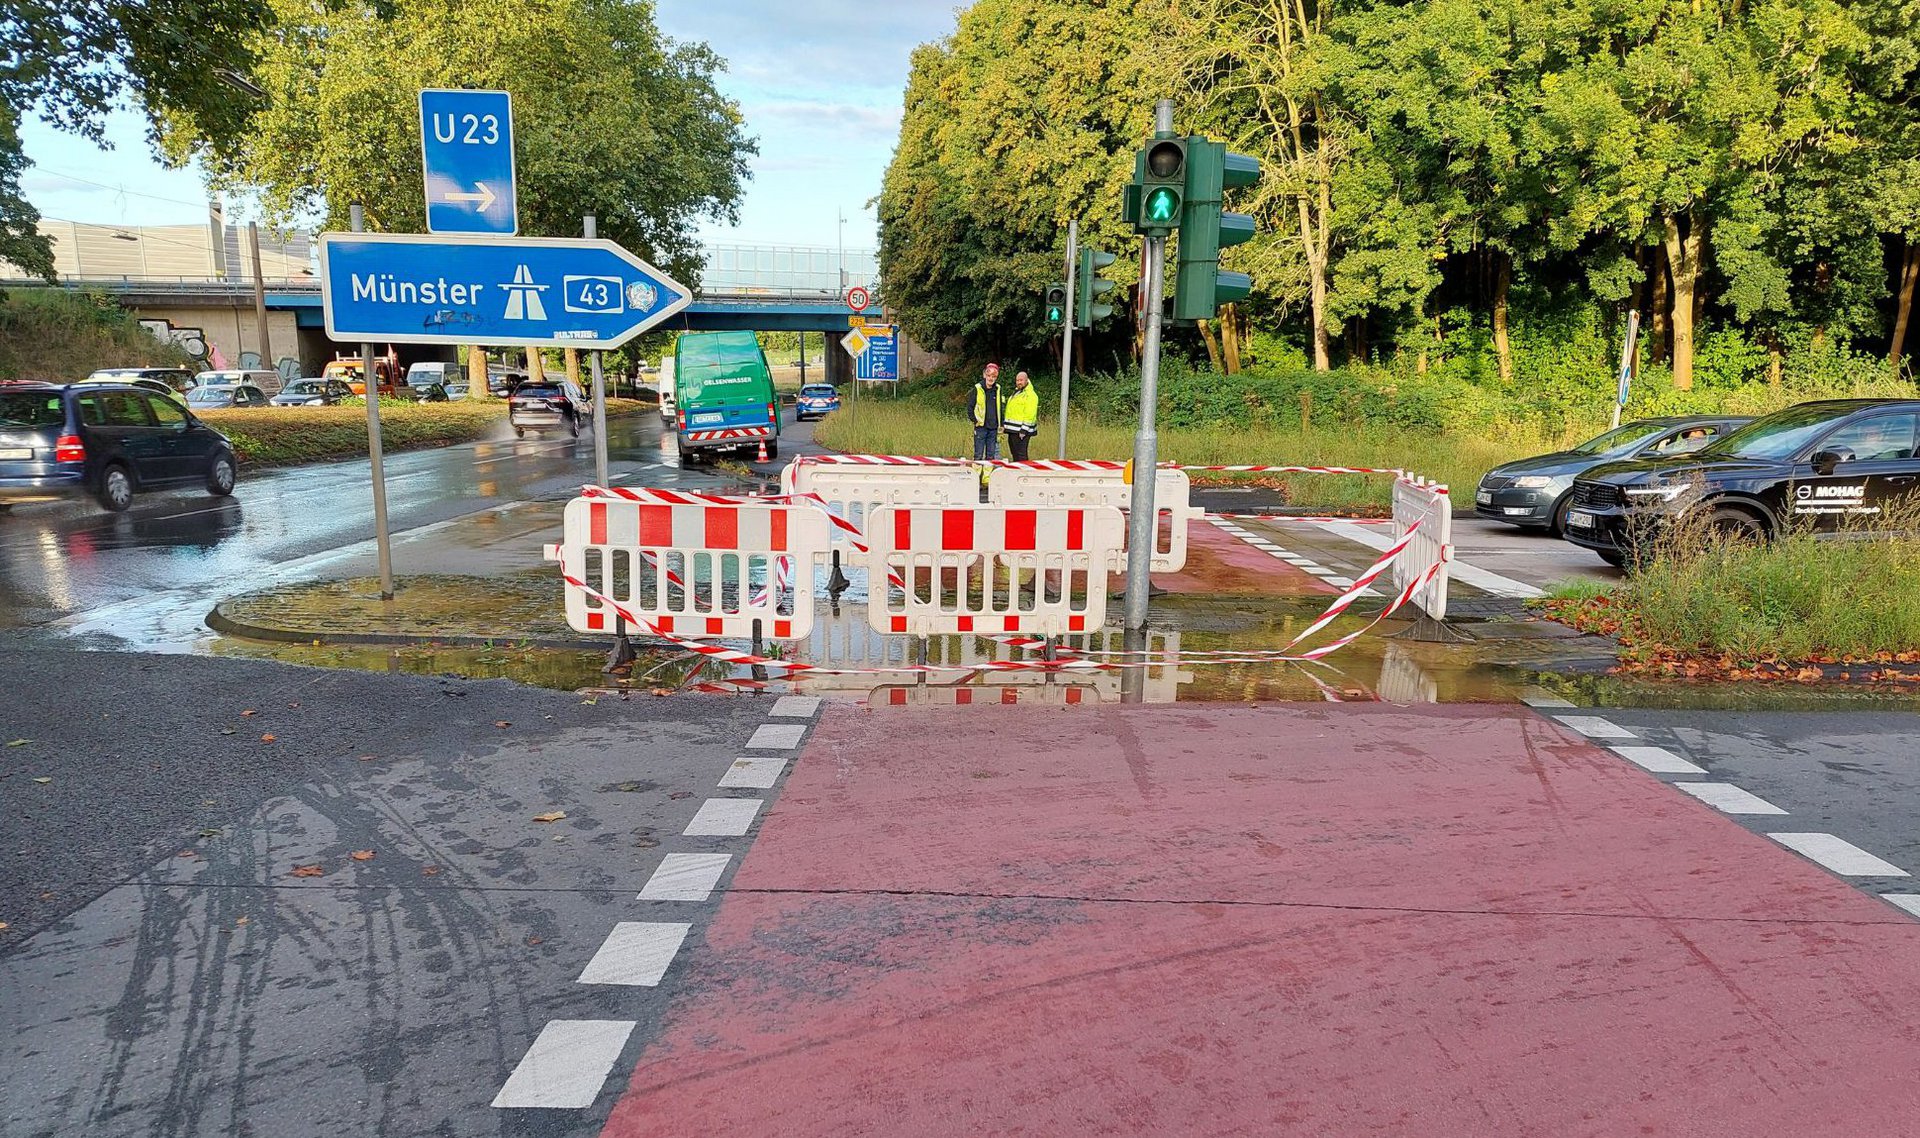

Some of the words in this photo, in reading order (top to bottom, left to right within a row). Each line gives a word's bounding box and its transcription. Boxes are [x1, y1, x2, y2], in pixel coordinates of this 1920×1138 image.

[433, 113, 455, 144] U
[462, 113, 499, 145] 23
[351, 273, 484, 305] Münster
[579, 283, 609, 305] 43
[851, 293, 865, 305] 50
[850, 317, 863, 325] 225
[703, 376, 752, 386] GELSENWASSER
[1815, 486, 1865, 498] MOHAG
[1795, 507, 1845, 515] Recklinghausen
